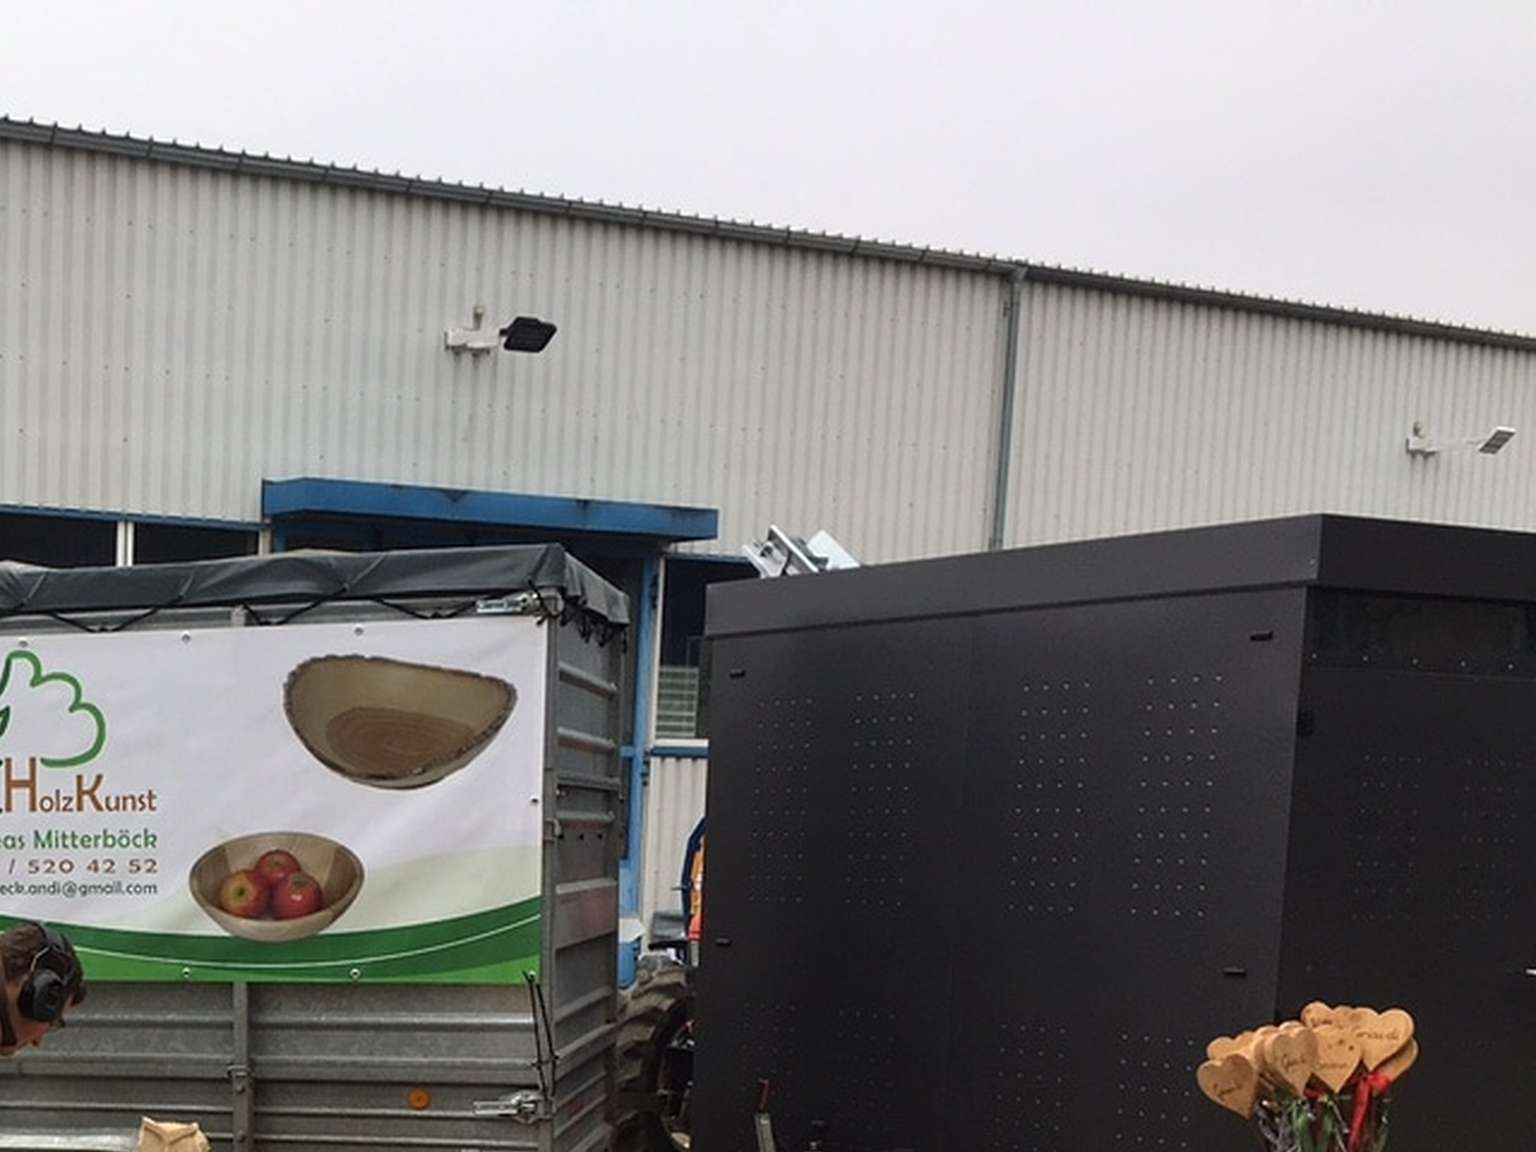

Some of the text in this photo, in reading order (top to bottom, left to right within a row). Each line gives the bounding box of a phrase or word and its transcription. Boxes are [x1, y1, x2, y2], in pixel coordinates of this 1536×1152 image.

[4, 756, 157, 813] HolzKunst
[32, 827, 158, 850] Mitterböck
[27, 858, 75, 874] 520
[86, 858, 117, 874] 42
[128, 858, 158, 874] 52
